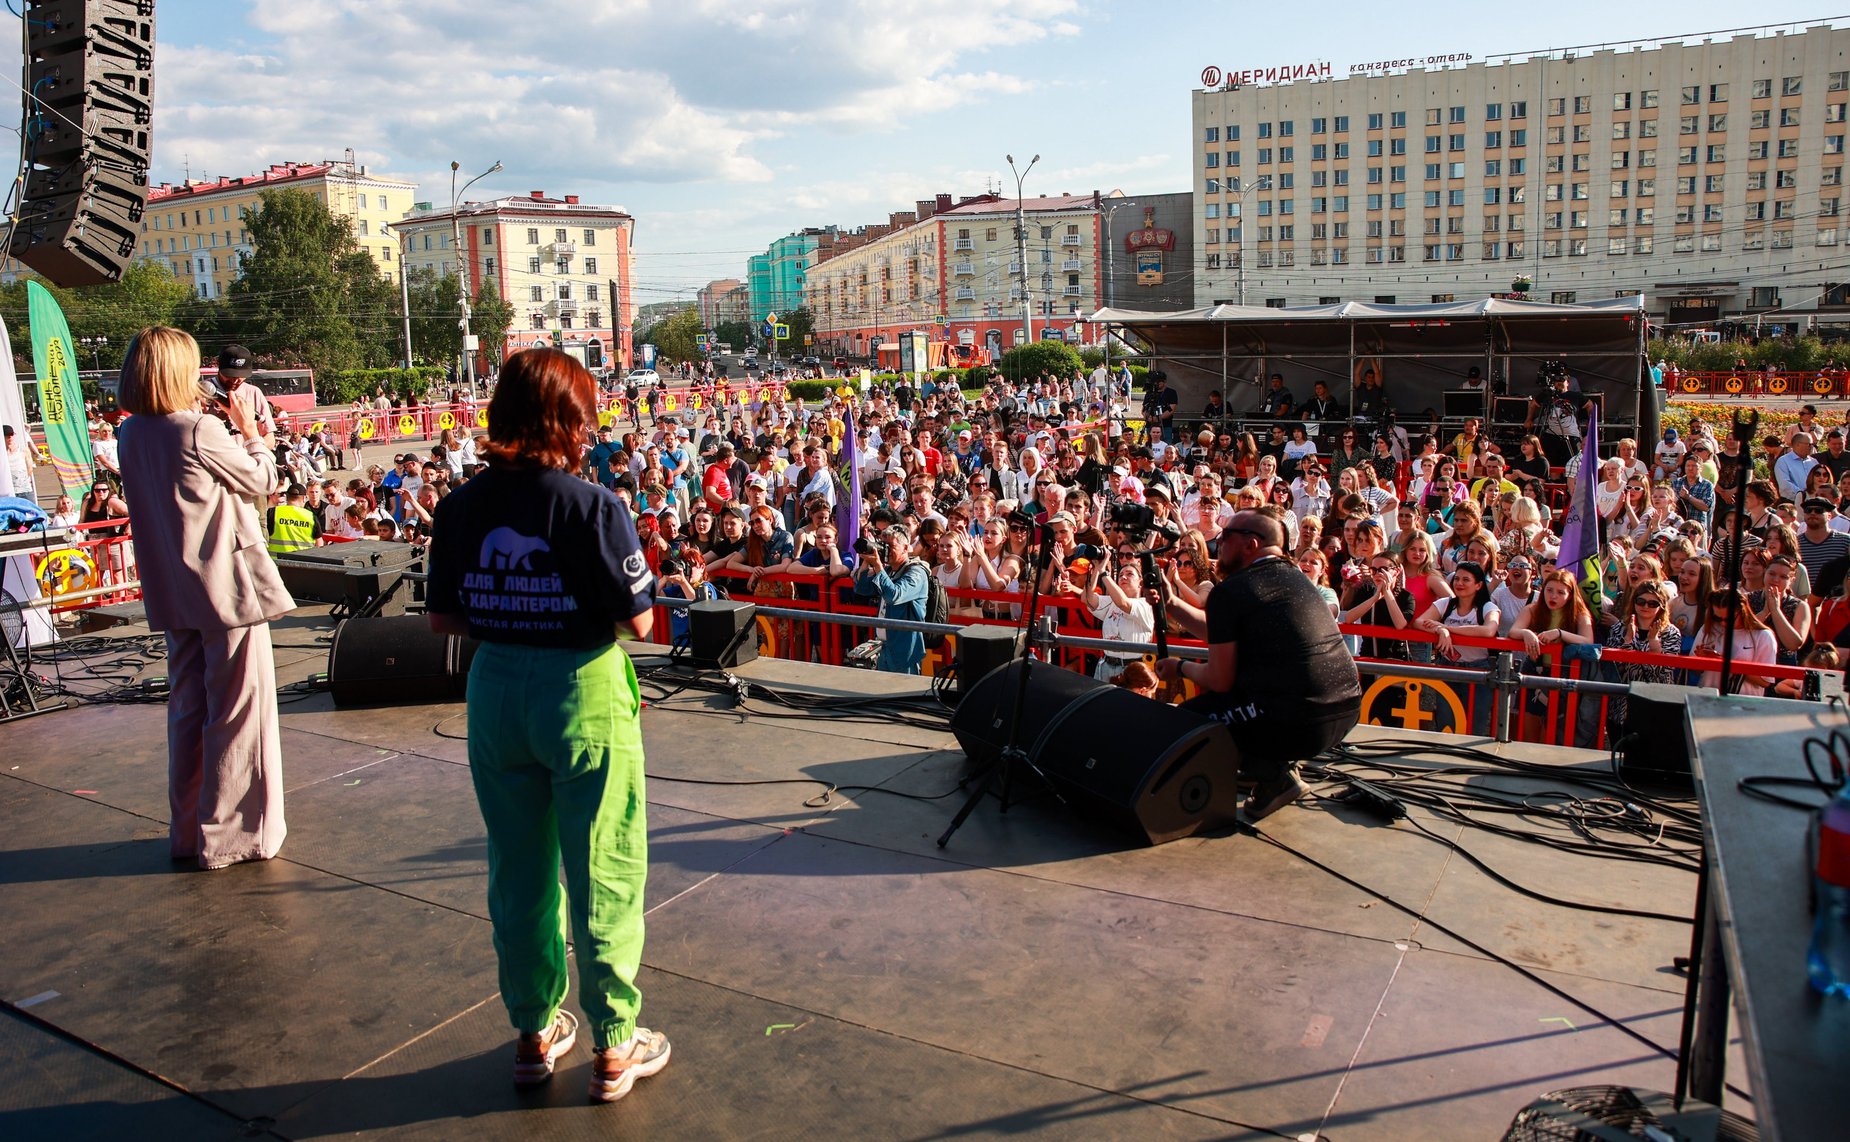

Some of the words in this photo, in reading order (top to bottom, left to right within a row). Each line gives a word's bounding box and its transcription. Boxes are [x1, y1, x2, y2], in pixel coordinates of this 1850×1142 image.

[1349, 58, 1415, 72] конгресс
[1427, 53, 1473, 64] отель
[1227, 61, 1331, 85] МЕРИДИАН
[45, 382, 59, 421] ДЕНЬ
[279, 518, 310, 528] ОХРАНА
[463, 572, 494, 590] ДЛЯ
[504, 572, 563, 592] ЛЮДЕЙ
[469, 592, 578, 613] ХАРАКТЕРОМ
[469, 615, 508, 630] ЧИСТАЯ
[512, 620, 564, 630] АРКТИКА
